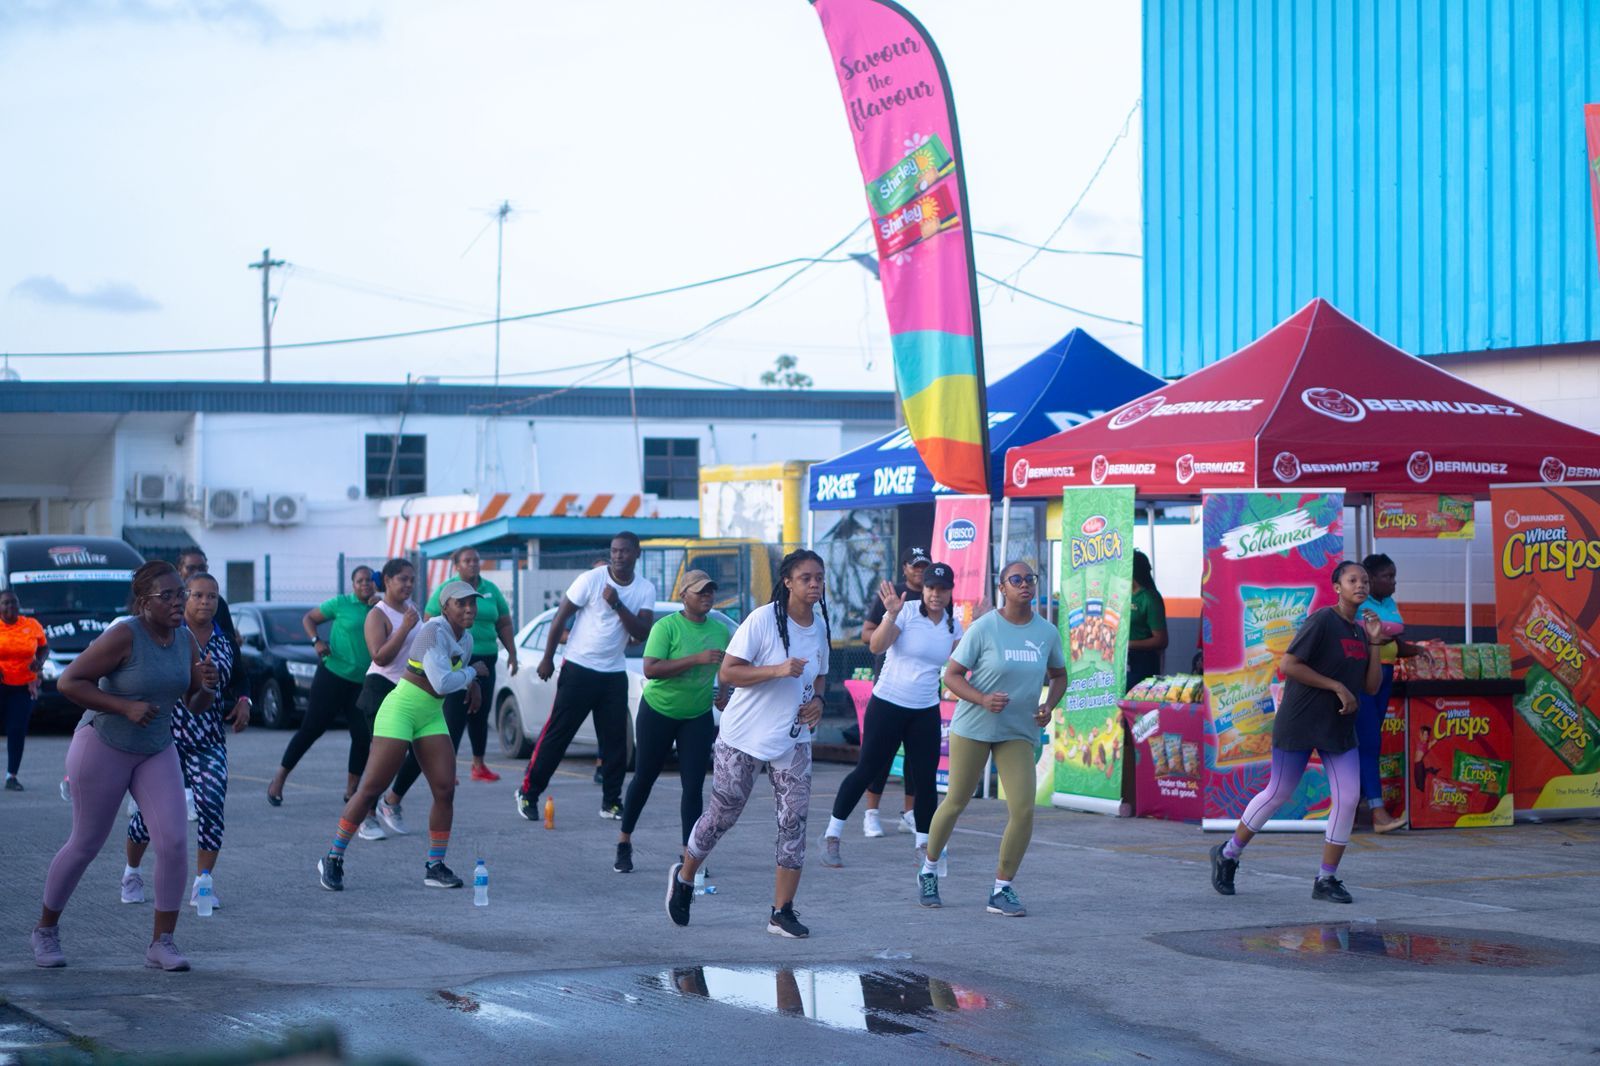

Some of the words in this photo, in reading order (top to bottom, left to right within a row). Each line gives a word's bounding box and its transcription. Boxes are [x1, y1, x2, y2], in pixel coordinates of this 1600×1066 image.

[840, 36, 920, 80] Savour
[867, 73, 893, 92] the
[851, 80, 935, 131] flavour
[880, 159, 918, 199] Shirley
[881, 205, 922, 240] Shirley
[1152, 398, 1264, 418] BERMUDEZ
[1361, 397, 1523, 417] BERMUDEZ
[1028, 465, 1075, 479] BERMUDEZ
[1107, 463, 1156, 476] BERMUDEZ
[1194, 461, 1245, 474] BERMUDEZ
[1301, 460, 1380, 474] BERMUDEZ
[1435, 461, 1508, 475] BERMUDEZ
[816, 472, 860, 501] DIXEE
[873, 465, 917, 497] DIXEE
[1377, 510, 1418, 531] Crisps
[1520, 514, 1565, 523] BERMUDEZ
[1237, 525, 1312, 558] Soldanza
[1525, 527, 1568, 544] Wheat
[1502, 531, 1600, 580] Crisps
[45, 622, 76, 639] ing
[1546, 621, 1573, 643] Wheat
[1525, 616, 1587, 669] Crisps
[1004, 649, 1038, 663] PUMA
[1554, 698, 1579, 721] Wheat
[1381, 718, 1406, 735] risps
[1434, 711, 1490, 741] Crisps
[1531, 693, 1592, 749] Crisps
[1157, 779, 1176, 788] Under
[1464, 765, 1497, 783] Crisps
[1161, 787, 1171, 796] it's
[1171, 788, 1179, 796] all
